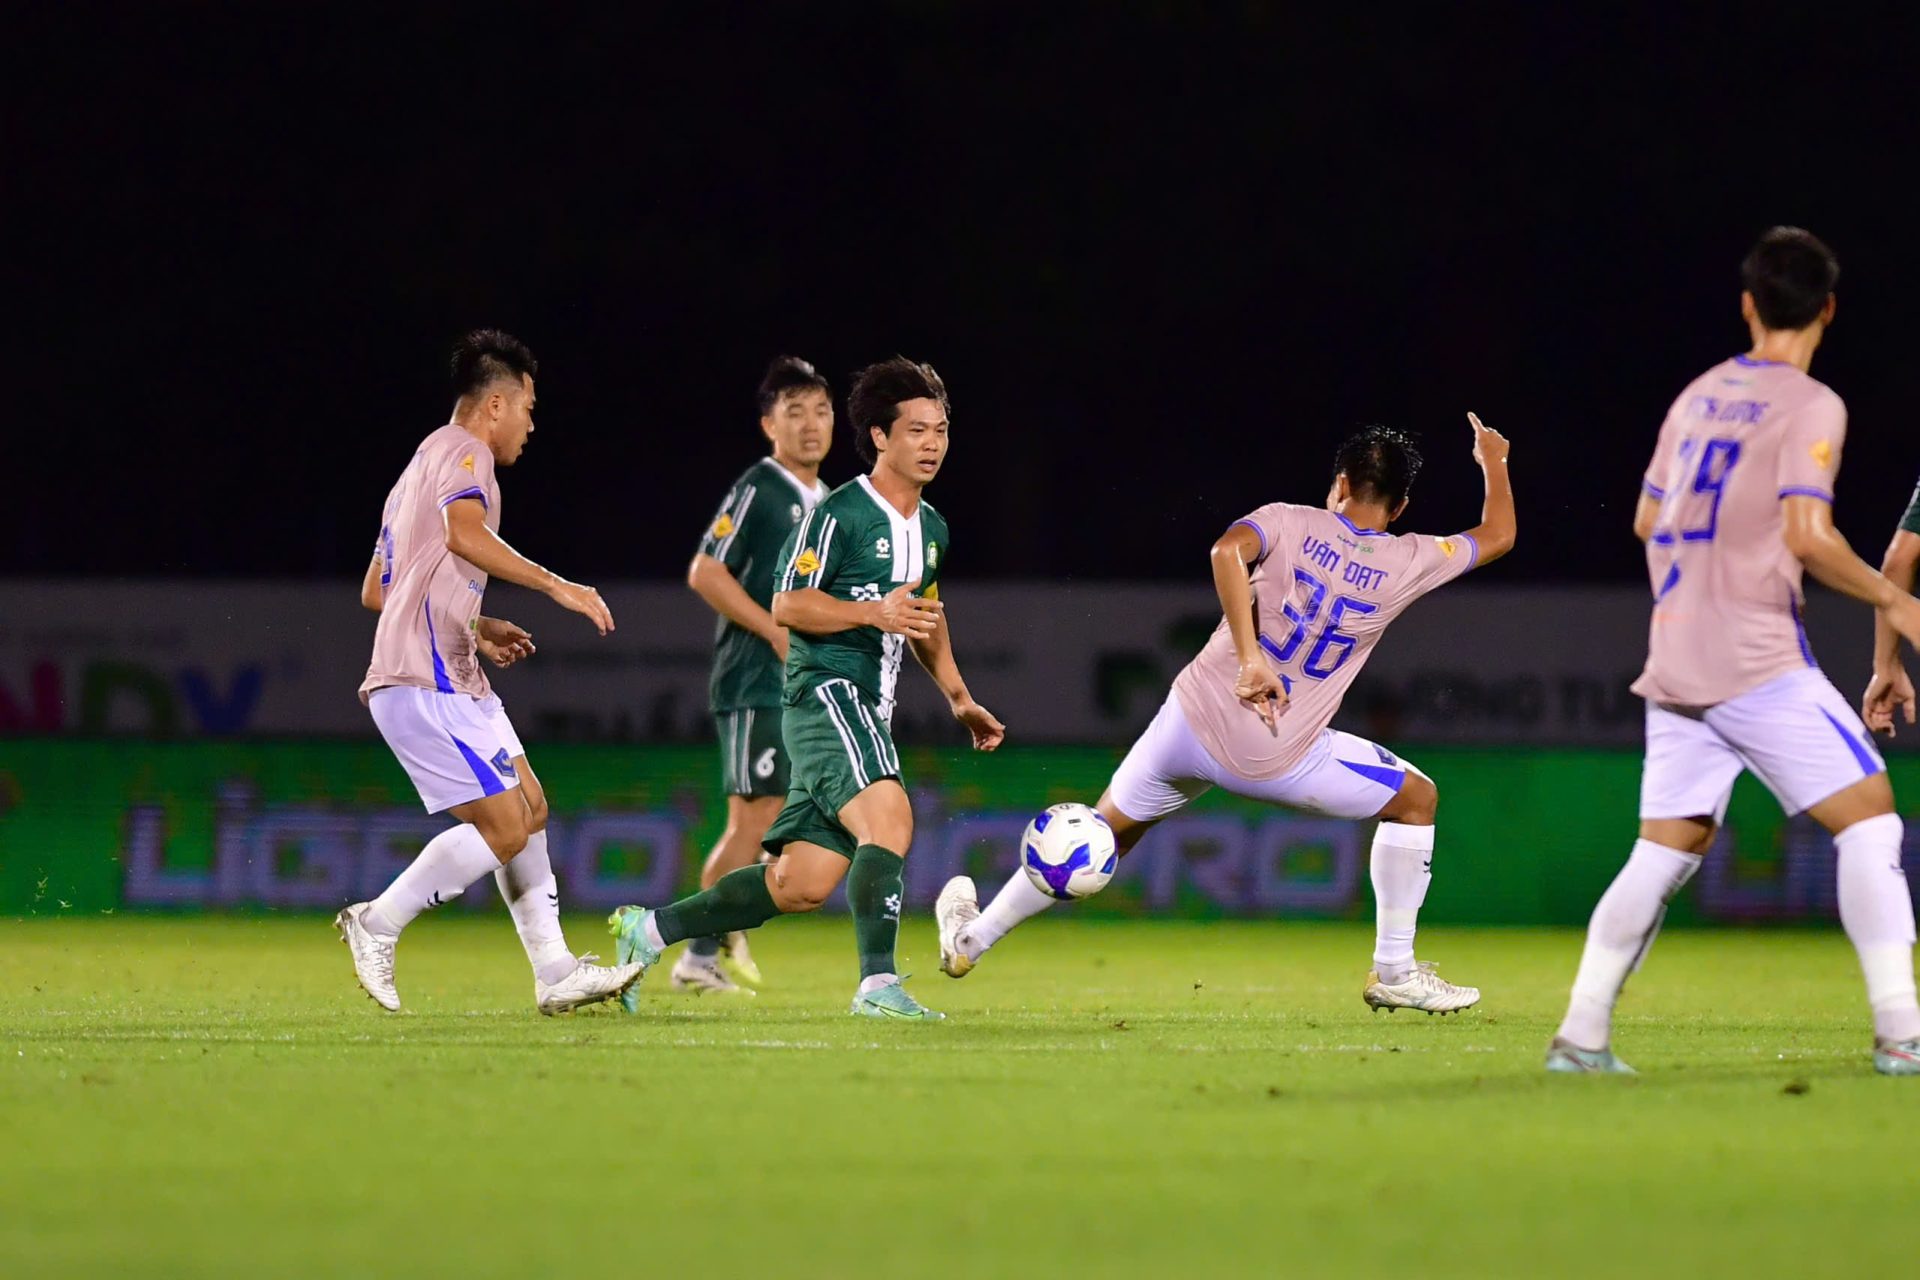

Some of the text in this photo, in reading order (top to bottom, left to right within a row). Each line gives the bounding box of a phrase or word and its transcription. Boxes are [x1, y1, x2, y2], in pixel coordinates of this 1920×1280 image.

[1303, 536, 1341, 572] VĂN
[1344, 561, 1388, 591] ĐẠT
[1258, 567, 1379, 680] 36
[755, 747, 777, 779] 6
